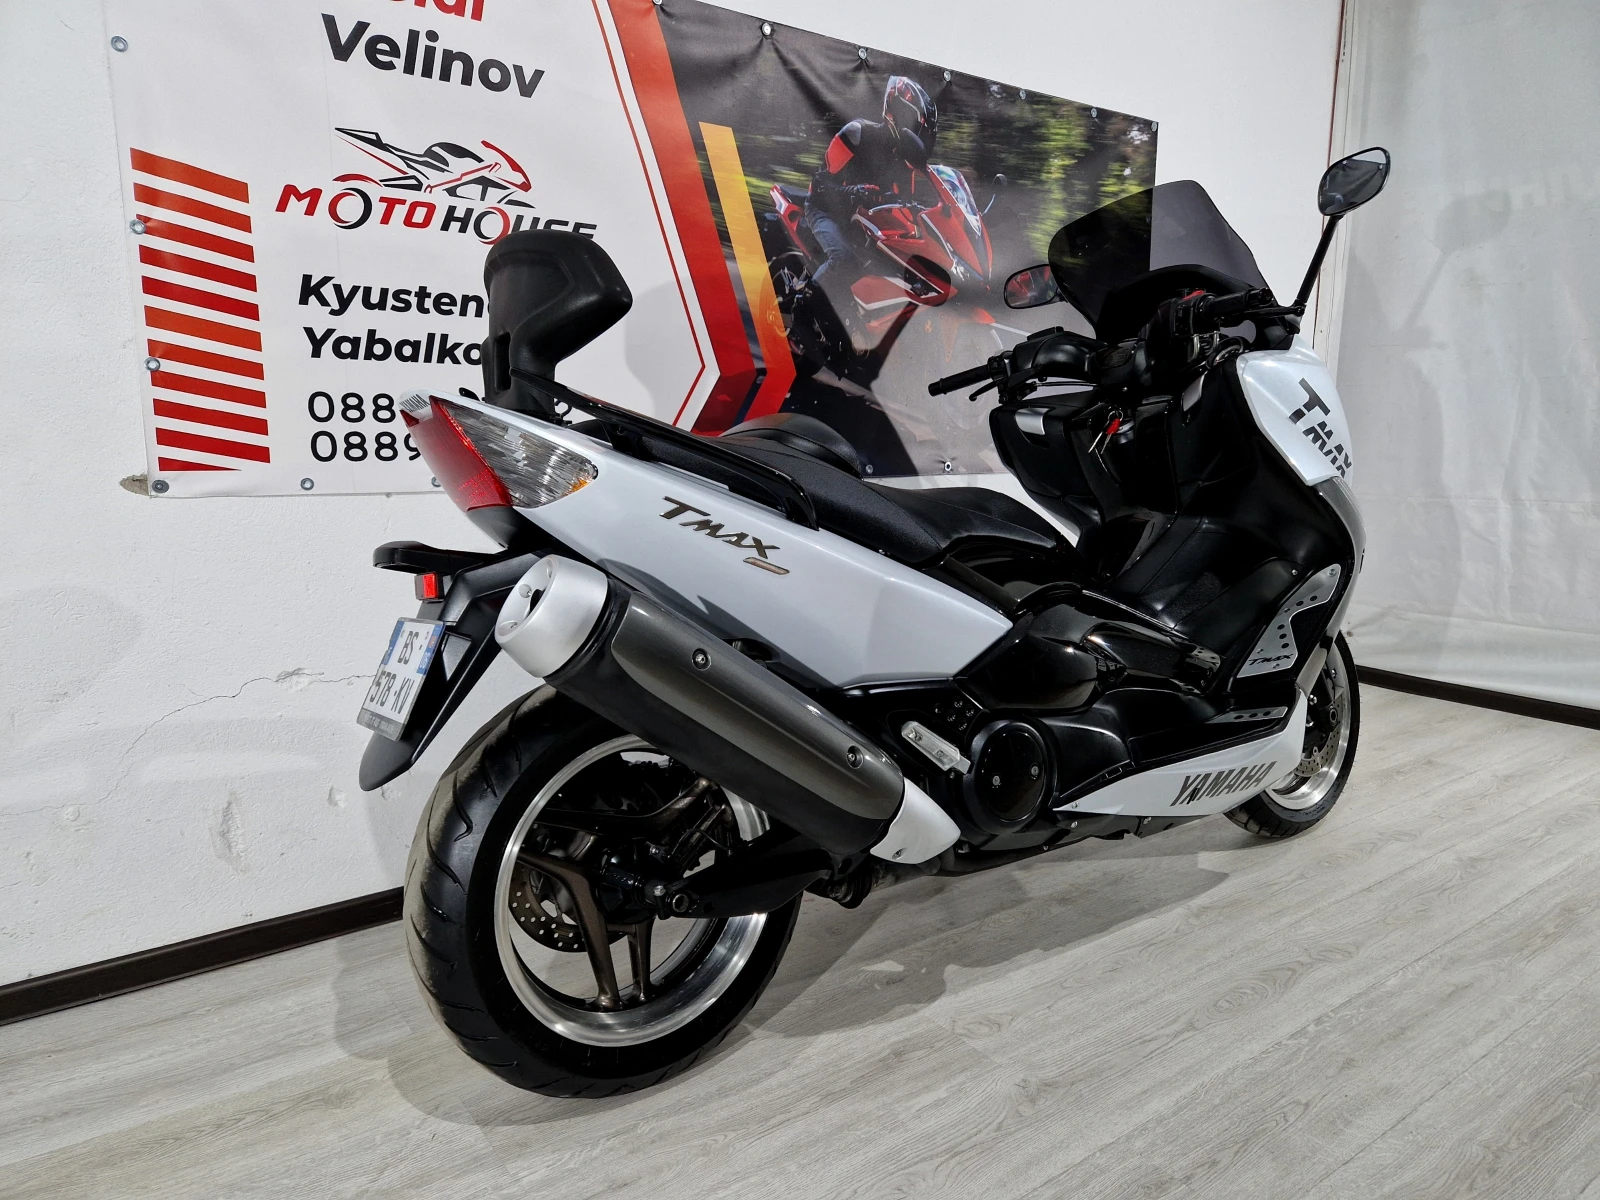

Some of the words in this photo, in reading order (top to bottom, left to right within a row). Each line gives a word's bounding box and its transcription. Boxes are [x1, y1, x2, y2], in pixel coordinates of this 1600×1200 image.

[321, 13, 545, 99] Velinov
[298, 274, 490, 318] Kyusten
[659, 495, 780, 560] TMAX
[1170, 761, 1277, 806] YAMAHA
